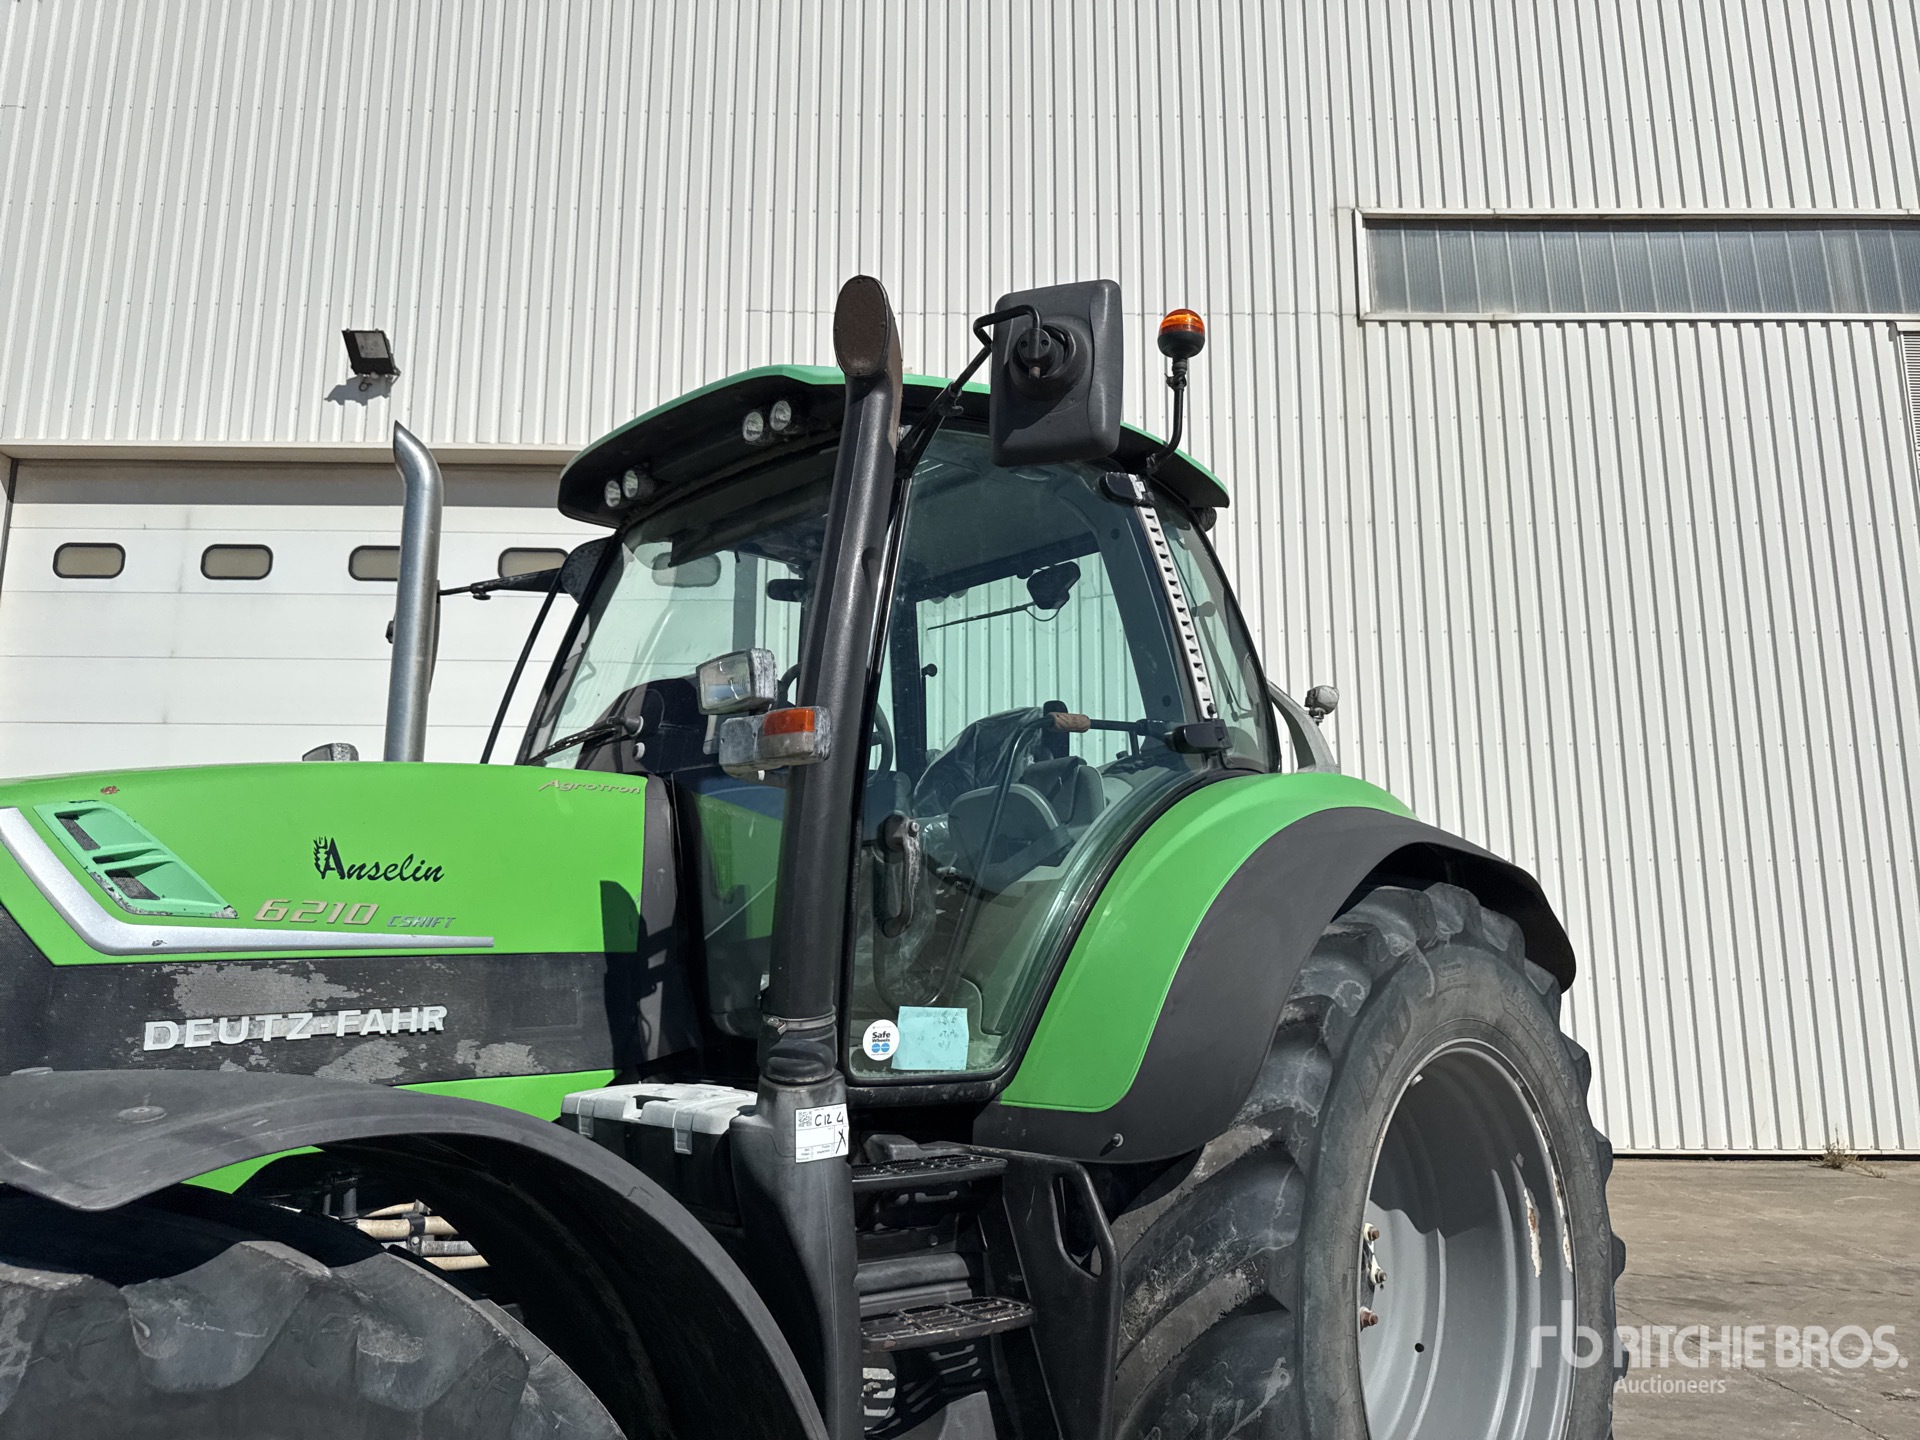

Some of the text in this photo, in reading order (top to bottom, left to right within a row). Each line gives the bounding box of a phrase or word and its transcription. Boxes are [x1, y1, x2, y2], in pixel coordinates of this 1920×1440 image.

[319, 837, 445, 882] Anselin
[254, 899, 457, 928] 6210 CSHIFT
[143, 1005, 448, 1051] DEUTZ-FAHR
[872, 1031, 891, 1039] Safe
